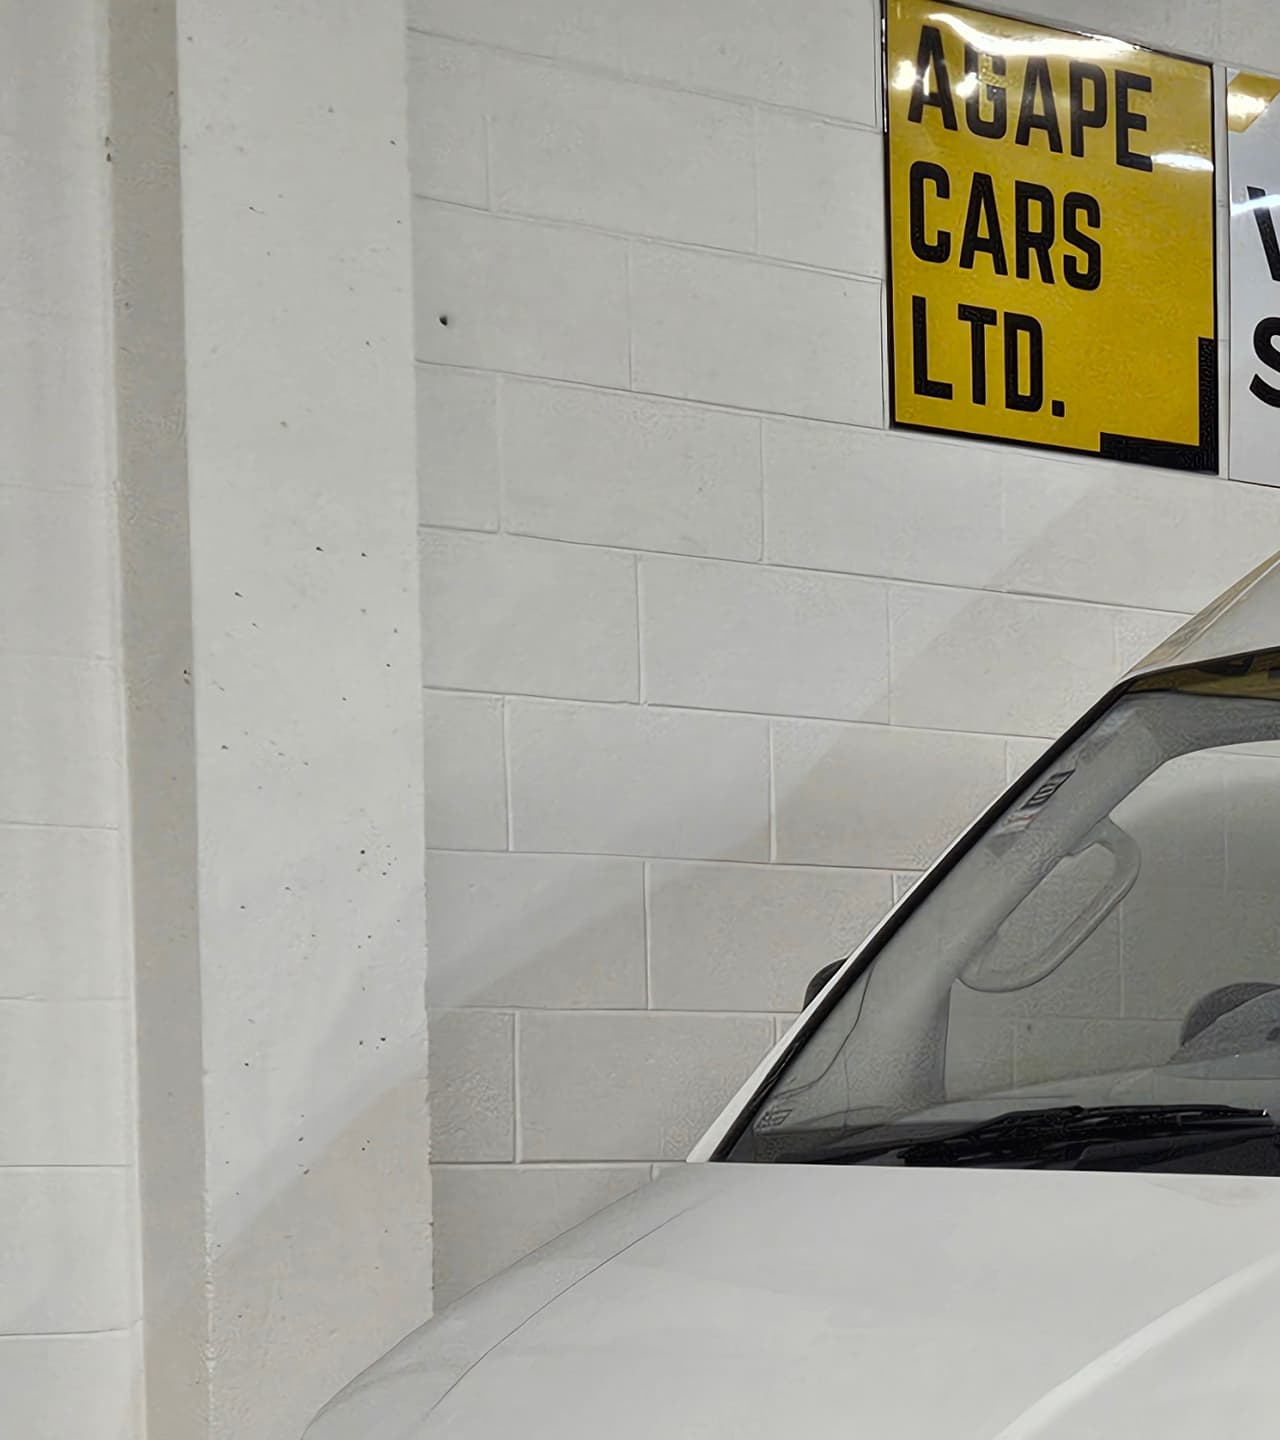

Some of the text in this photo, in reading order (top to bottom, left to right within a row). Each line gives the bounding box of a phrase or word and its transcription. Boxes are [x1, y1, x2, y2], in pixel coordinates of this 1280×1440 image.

[908, 25, 1153, 172] AGAPE
[910, 160, 1101, 291] CARS
[912, 295, 1065, 418] LTD.
